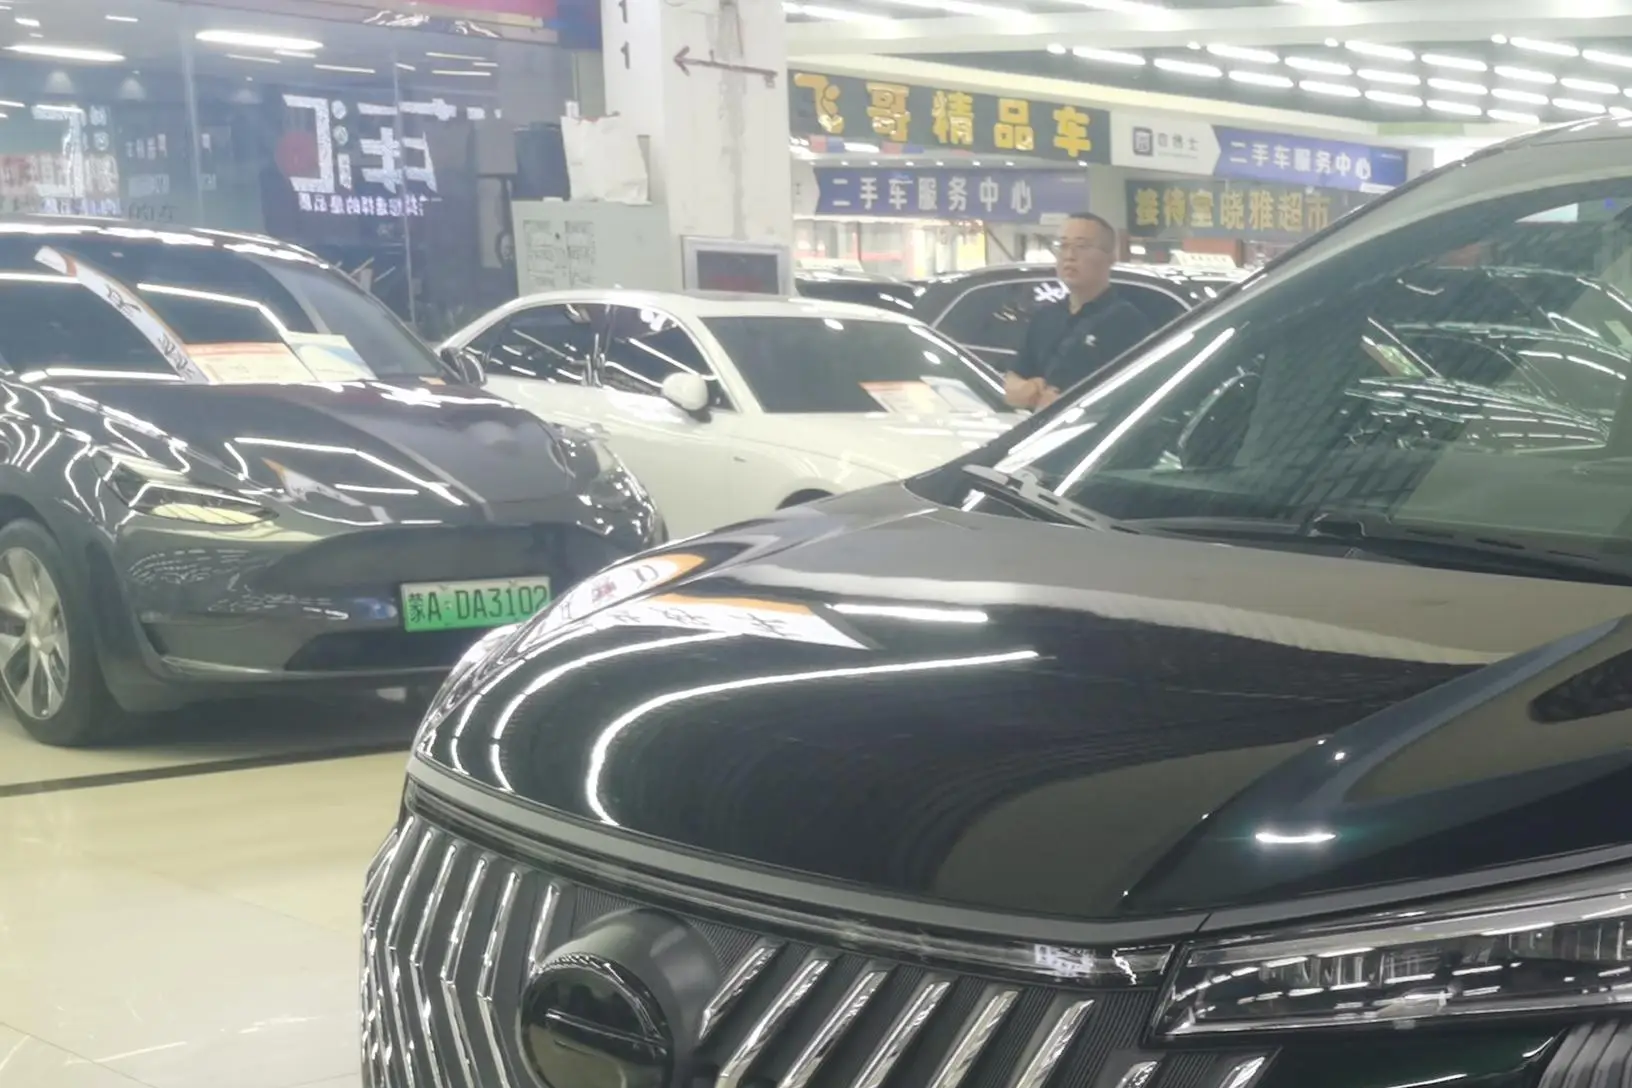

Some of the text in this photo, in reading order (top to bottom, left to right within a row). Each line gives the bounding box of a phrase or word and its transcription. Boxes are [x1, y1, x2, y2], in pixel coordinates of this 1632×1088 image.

[793, 72, 1092, 158] 飞哥精品车
[1229, 141, 1372, 181] 二手车服务中心
[832, 173, 1033, 214] 二手车服务中心
